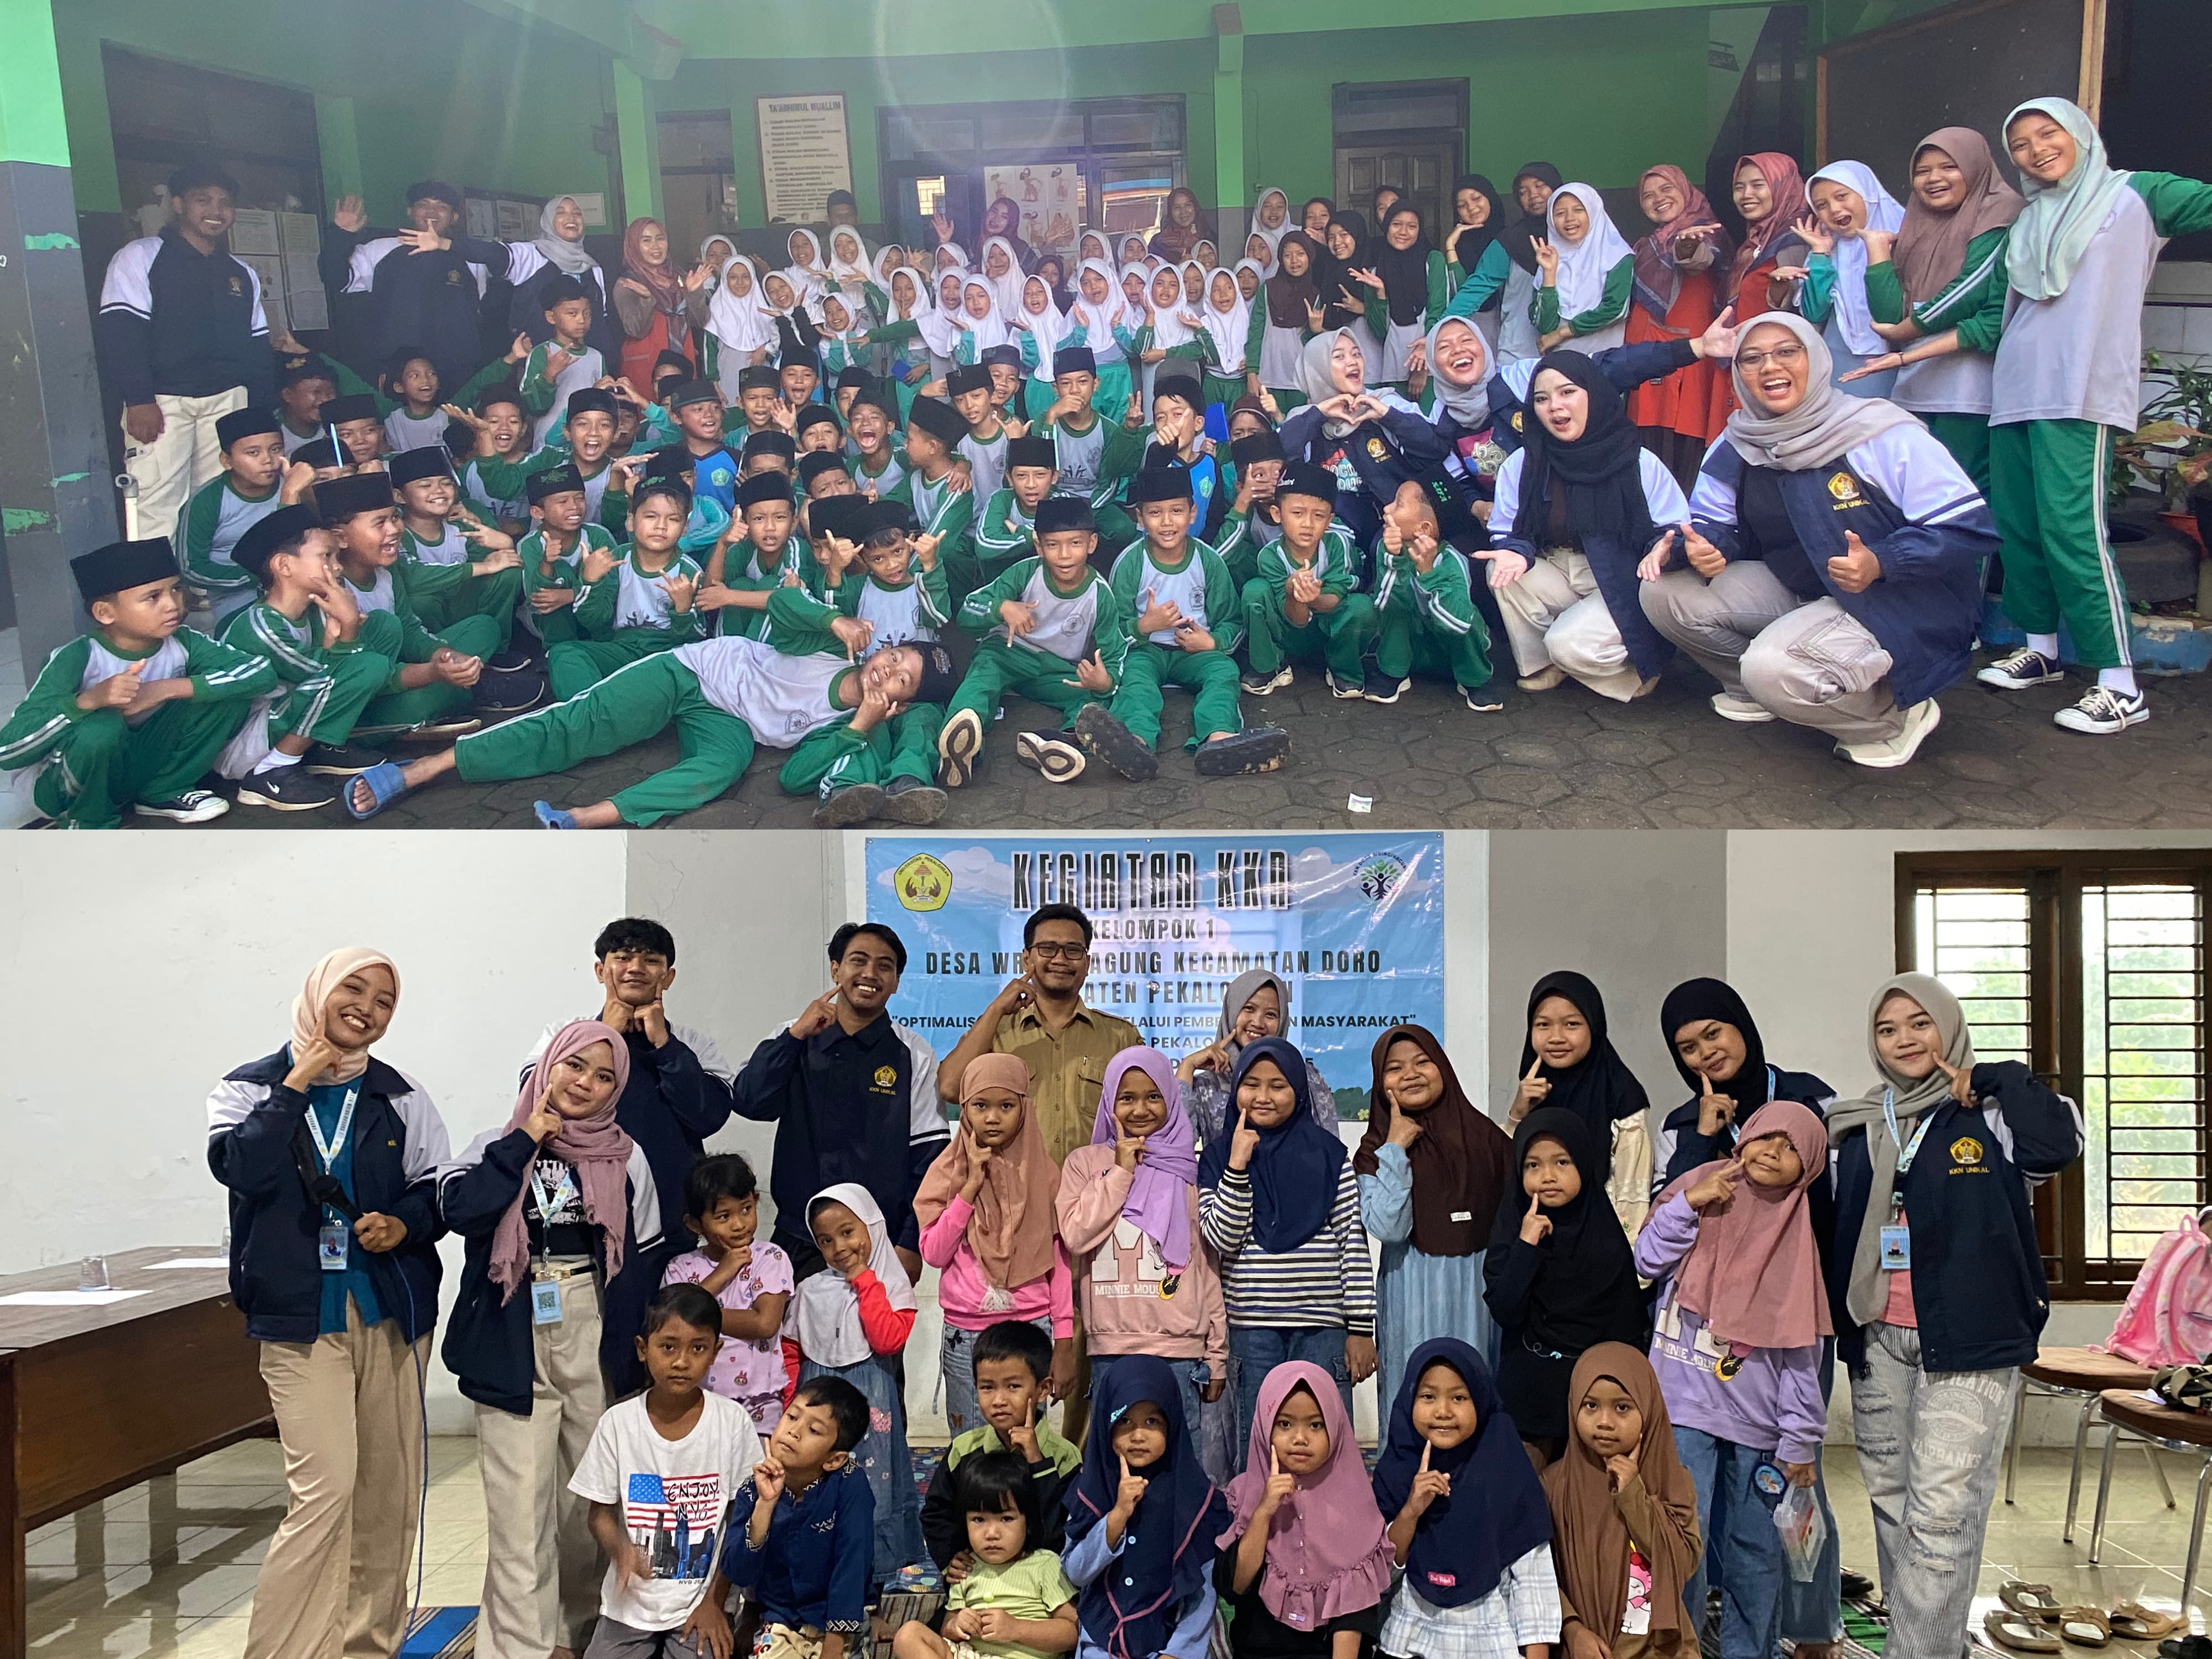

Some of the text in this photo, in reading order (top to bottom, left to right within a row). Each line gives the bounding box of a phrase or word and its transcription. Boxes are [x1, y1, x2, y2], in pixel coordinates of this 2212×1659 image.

[811, 101, 841, 111] MUALLIM
[898, 857, 922, 875] UNIVERSITAS
[1011, 849, 1288, 911] KEGIATAN KKN
[1092, 919, 1214, 940] KELOMPOK 1
[927, 952, 980, 974] DESA
[1174, 951, 1309, 974] KECAMATAN
[1322, 950, 1380, 973] DORO
[1301, 1014, 1416, 1027] MASYARAKAT"
[1094, 1284, 1130, 1295] MINNIE
[667, 1479, 718, 1502] ENJOY
